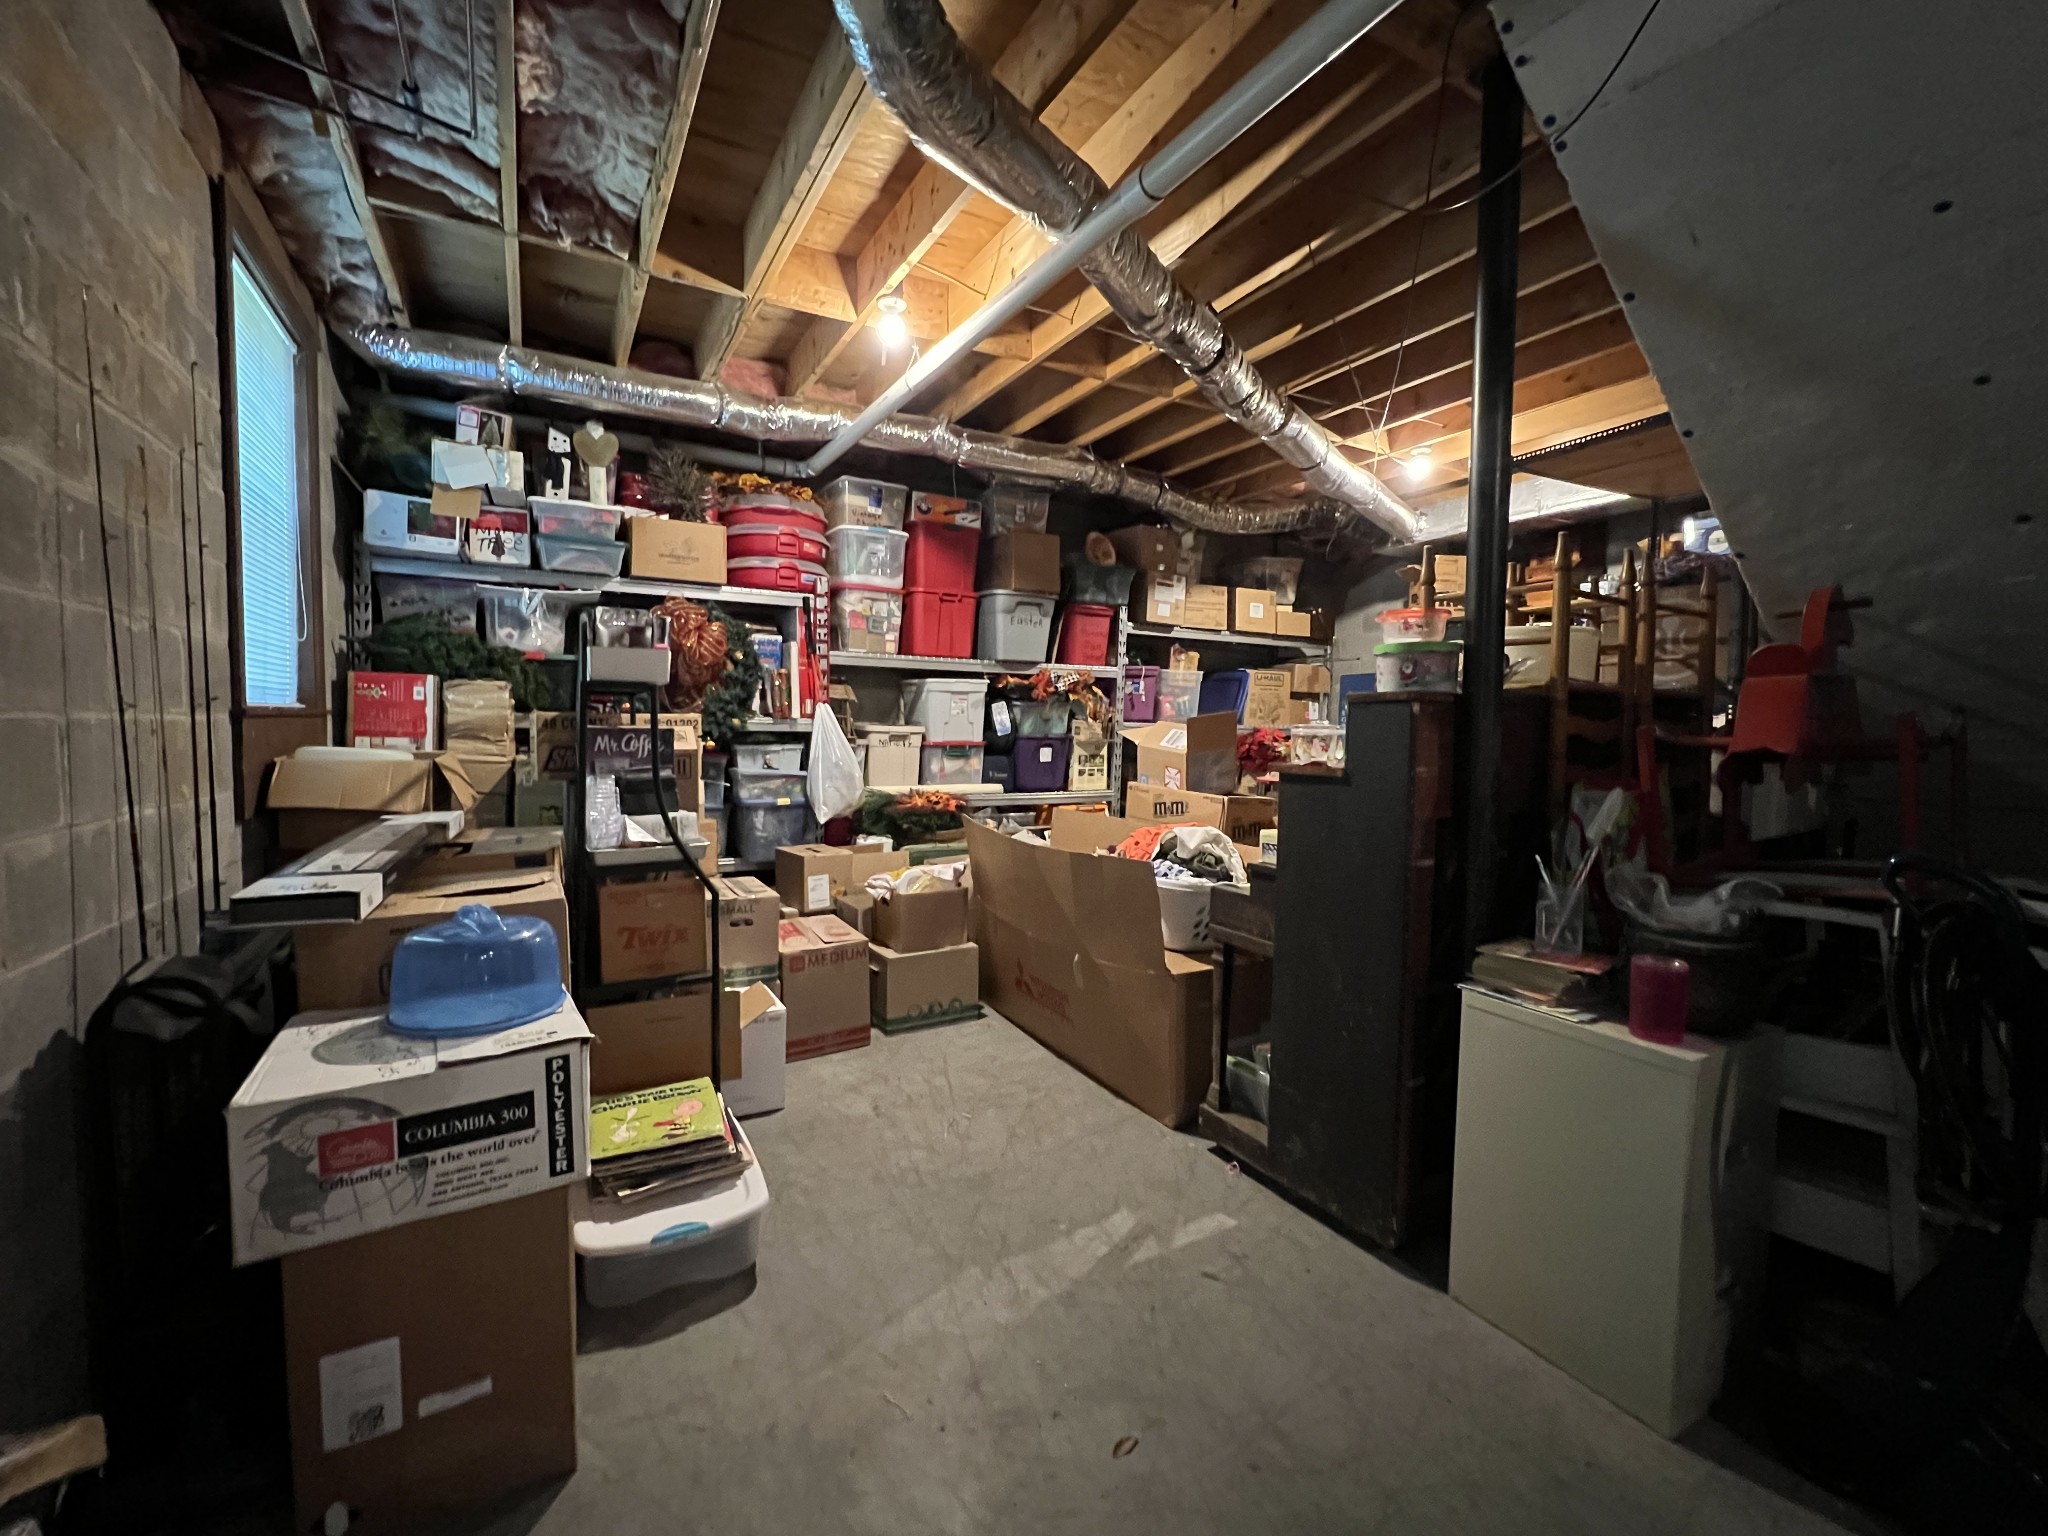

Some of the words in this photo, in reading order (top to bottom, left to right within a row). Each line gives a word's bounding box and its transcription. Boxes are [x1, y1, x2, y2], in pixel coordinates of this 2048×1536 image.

[594, 734, 619, 756] Mr.
[806, 948, 868, 968] MEDIUM
[404, 1116, 496, 1145] COLUMBIA
[500, 1105, 529, 1127] 300
[550, 1058, 568, 1173] POLYESTER
[441, 1152, 464, 1165] the
[467, 1138, 505, 1158] world
